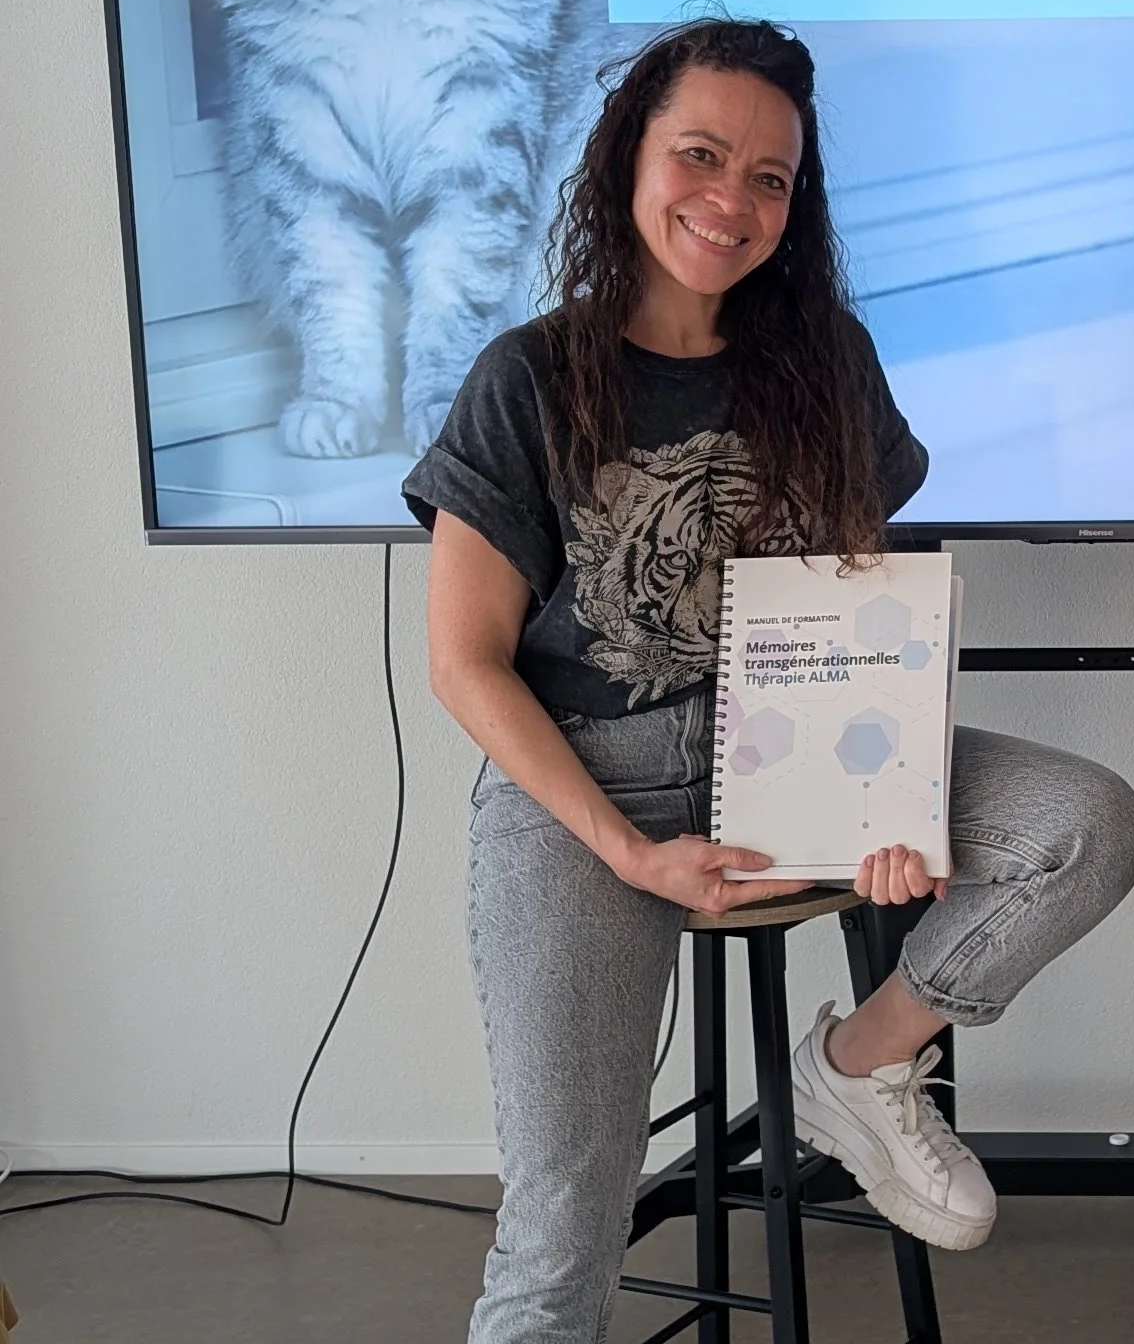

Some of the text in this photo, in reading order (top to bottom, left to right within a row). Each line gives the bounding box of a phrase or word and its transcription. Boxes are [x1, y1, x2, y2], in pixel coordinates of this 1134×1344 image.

[1078, 529, 1114, 537] Hisense
[746, 614, 841, 625] MANUEL DE FORMATION
[746, 640, 816, 654] Mémoires
[744, 652, 900, 671] transgénérationnelles
[744, 670, 851, 687] Thérapie ALMA
